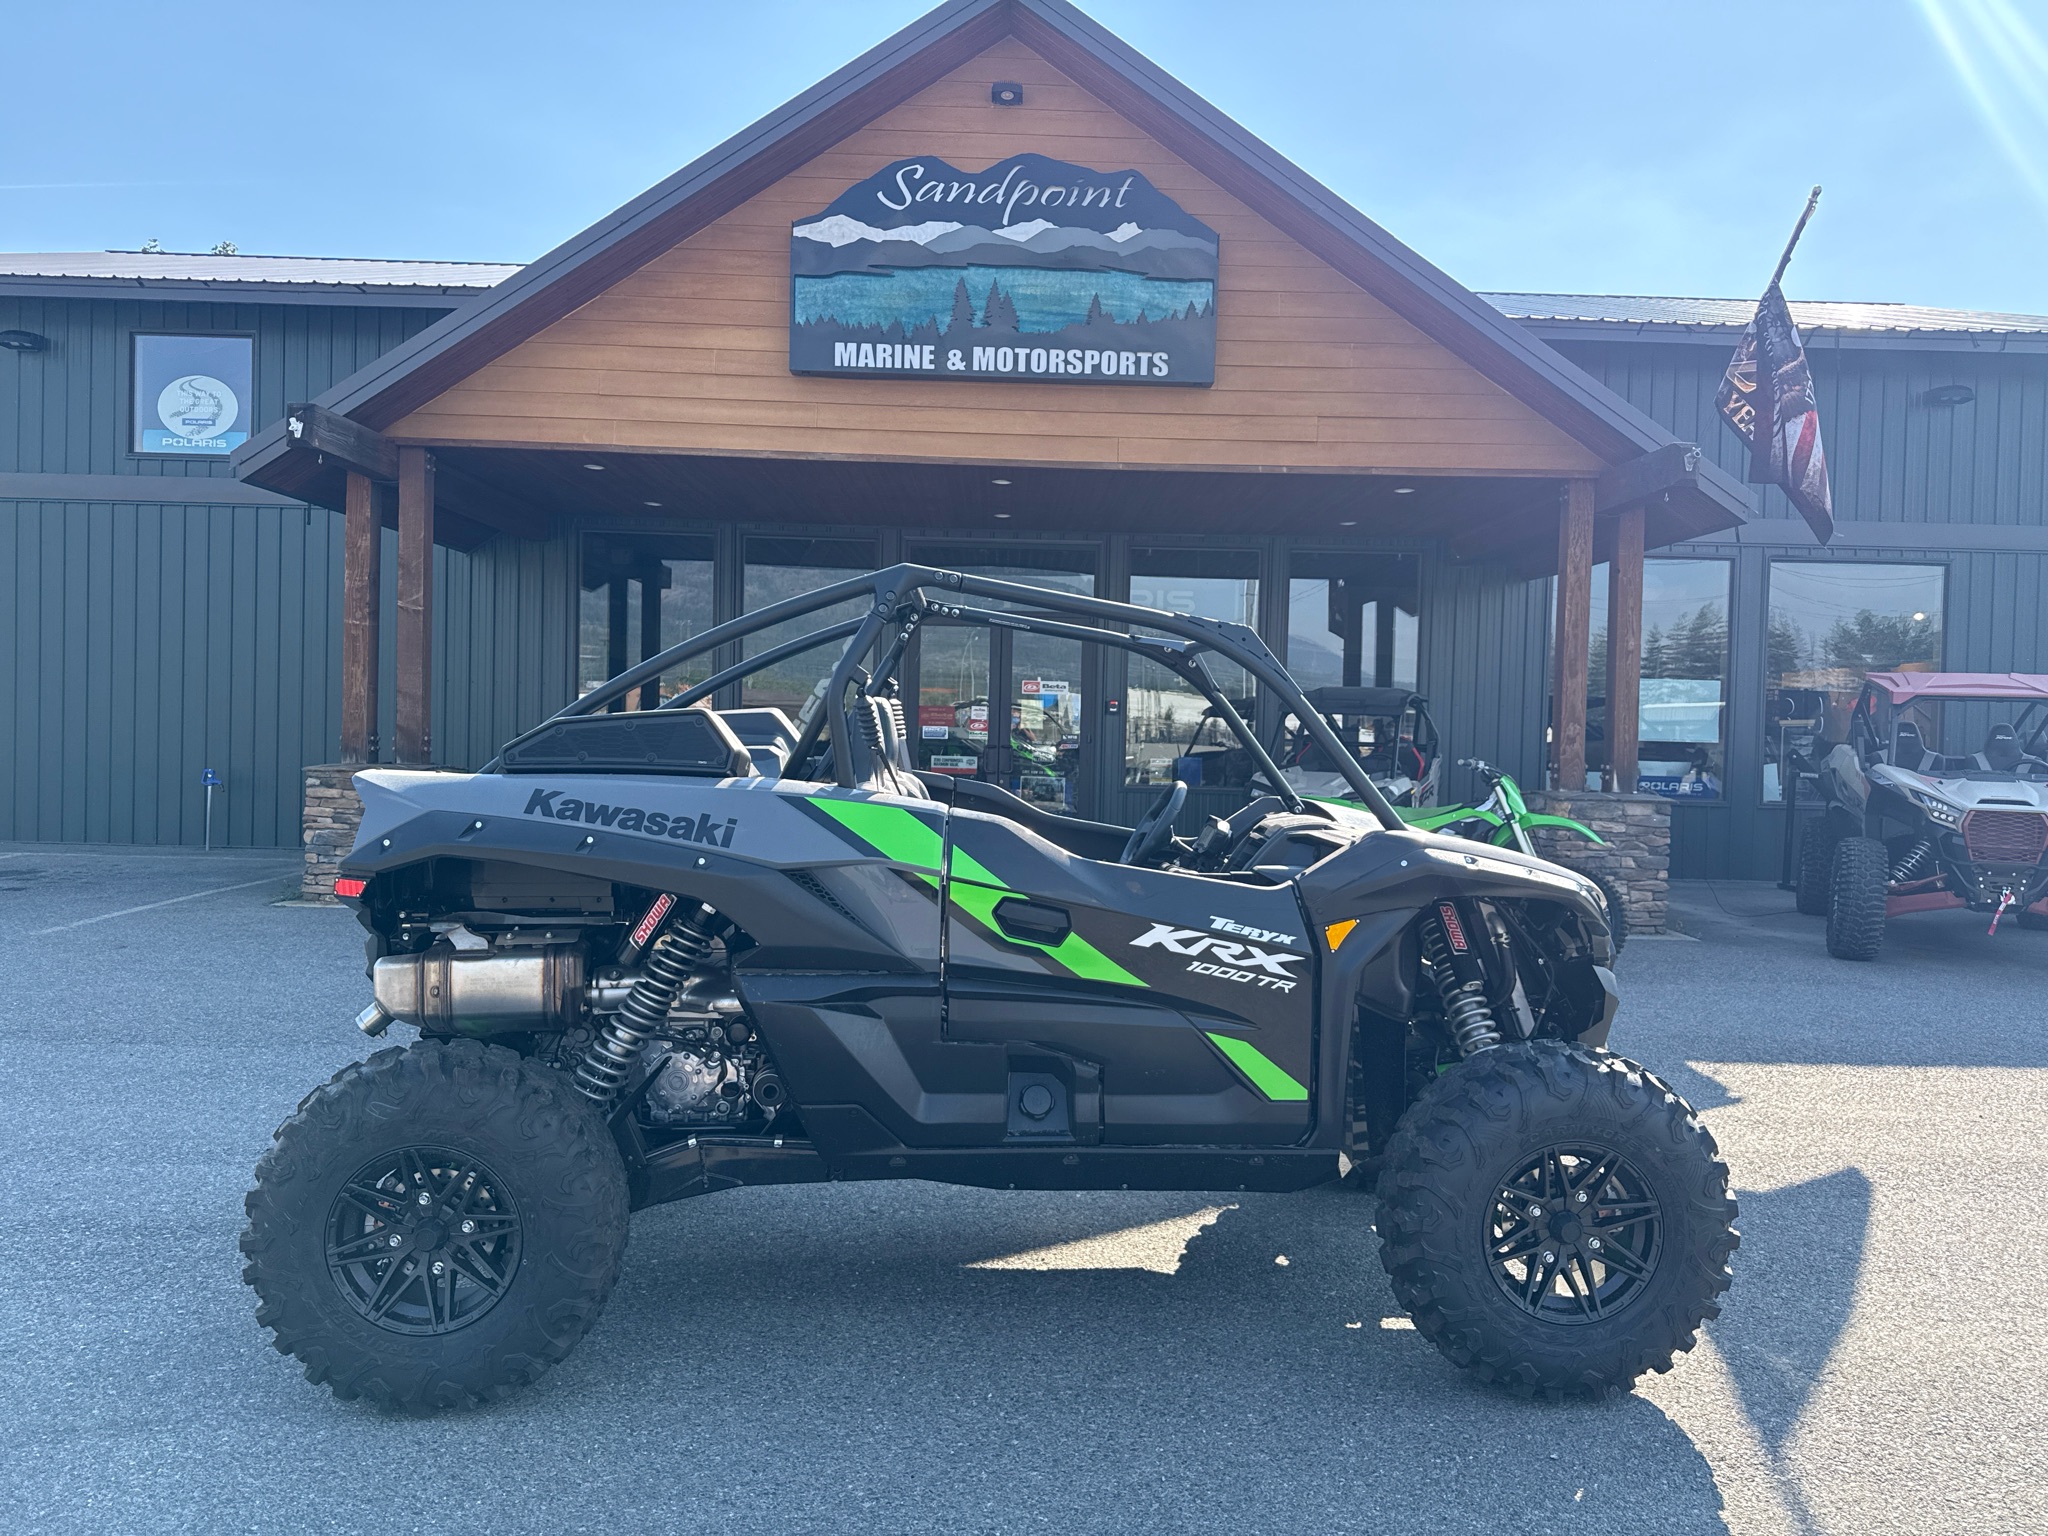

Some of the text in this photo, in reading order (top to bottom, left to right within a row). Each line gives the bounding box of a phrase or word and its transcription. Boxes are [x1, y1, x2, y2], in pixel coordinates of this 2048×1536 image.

[876, 164, 1135, 226] Sandpoint
[834, 342, 1170, 377] MARINE & MOTORSPORTS
[162, 437, 227, 448] POLARIS
[1638, 781, 1704, 792] POLARIS
[523, 788, 738, 849] Kawasaki
[635, 893, 671, 946] SHOWA
[1209, 915, 1298, 945] TERYX
[1440, 905, 1468, 950] SHOWA
[1129, 922, 1306, 979] KRX
